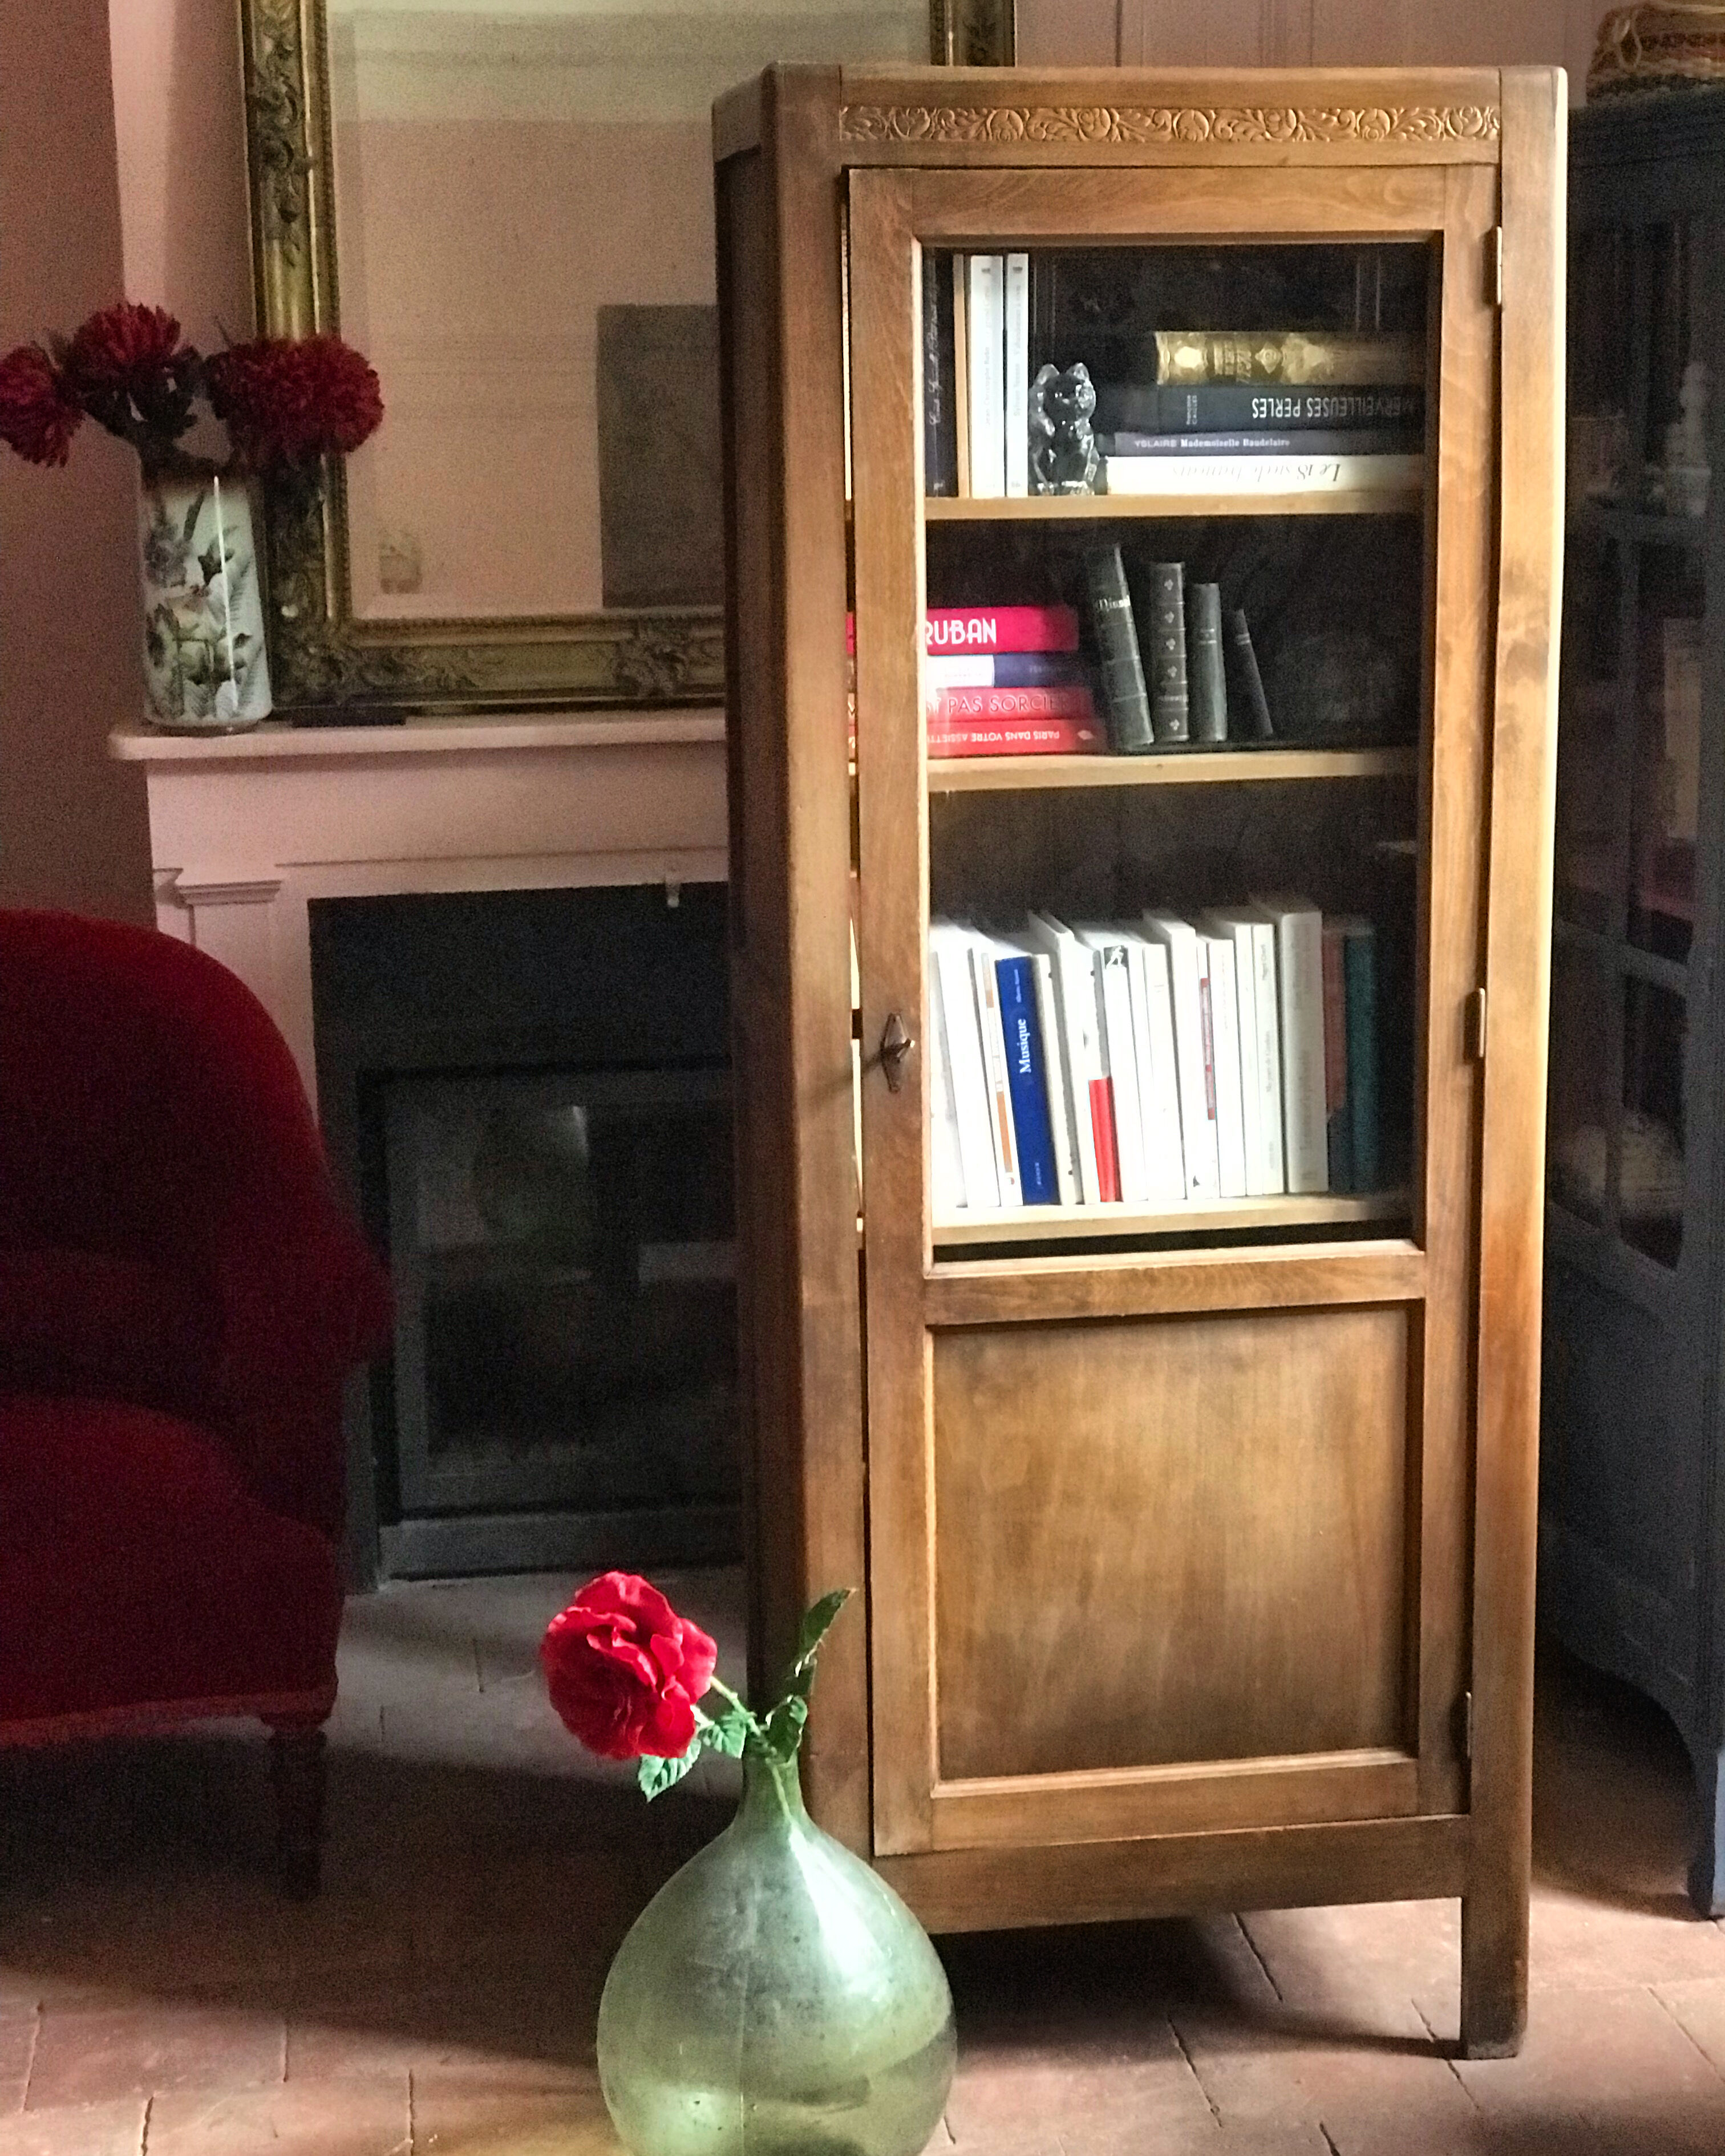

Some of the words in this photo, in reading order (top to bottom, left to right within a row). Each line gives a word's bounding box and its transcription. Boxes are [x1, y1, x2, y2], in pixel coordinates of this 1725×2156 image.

[1252, 398, 1301, 418] PERLES
[1180, 438, 1240, 448] Mademoiselle
[1242, 437, 1291, 447] Baudelaire
[1319, 463, 1341, 482] Le
[948, 695, 983, 713] PAS
[971, 732, 1003, 742] VOTRE
[1005, 731, 1031, 741] DANS
[1033, 730, 1060, 740] PARIS
[1017, 1018, 1032, 1074] Musique
